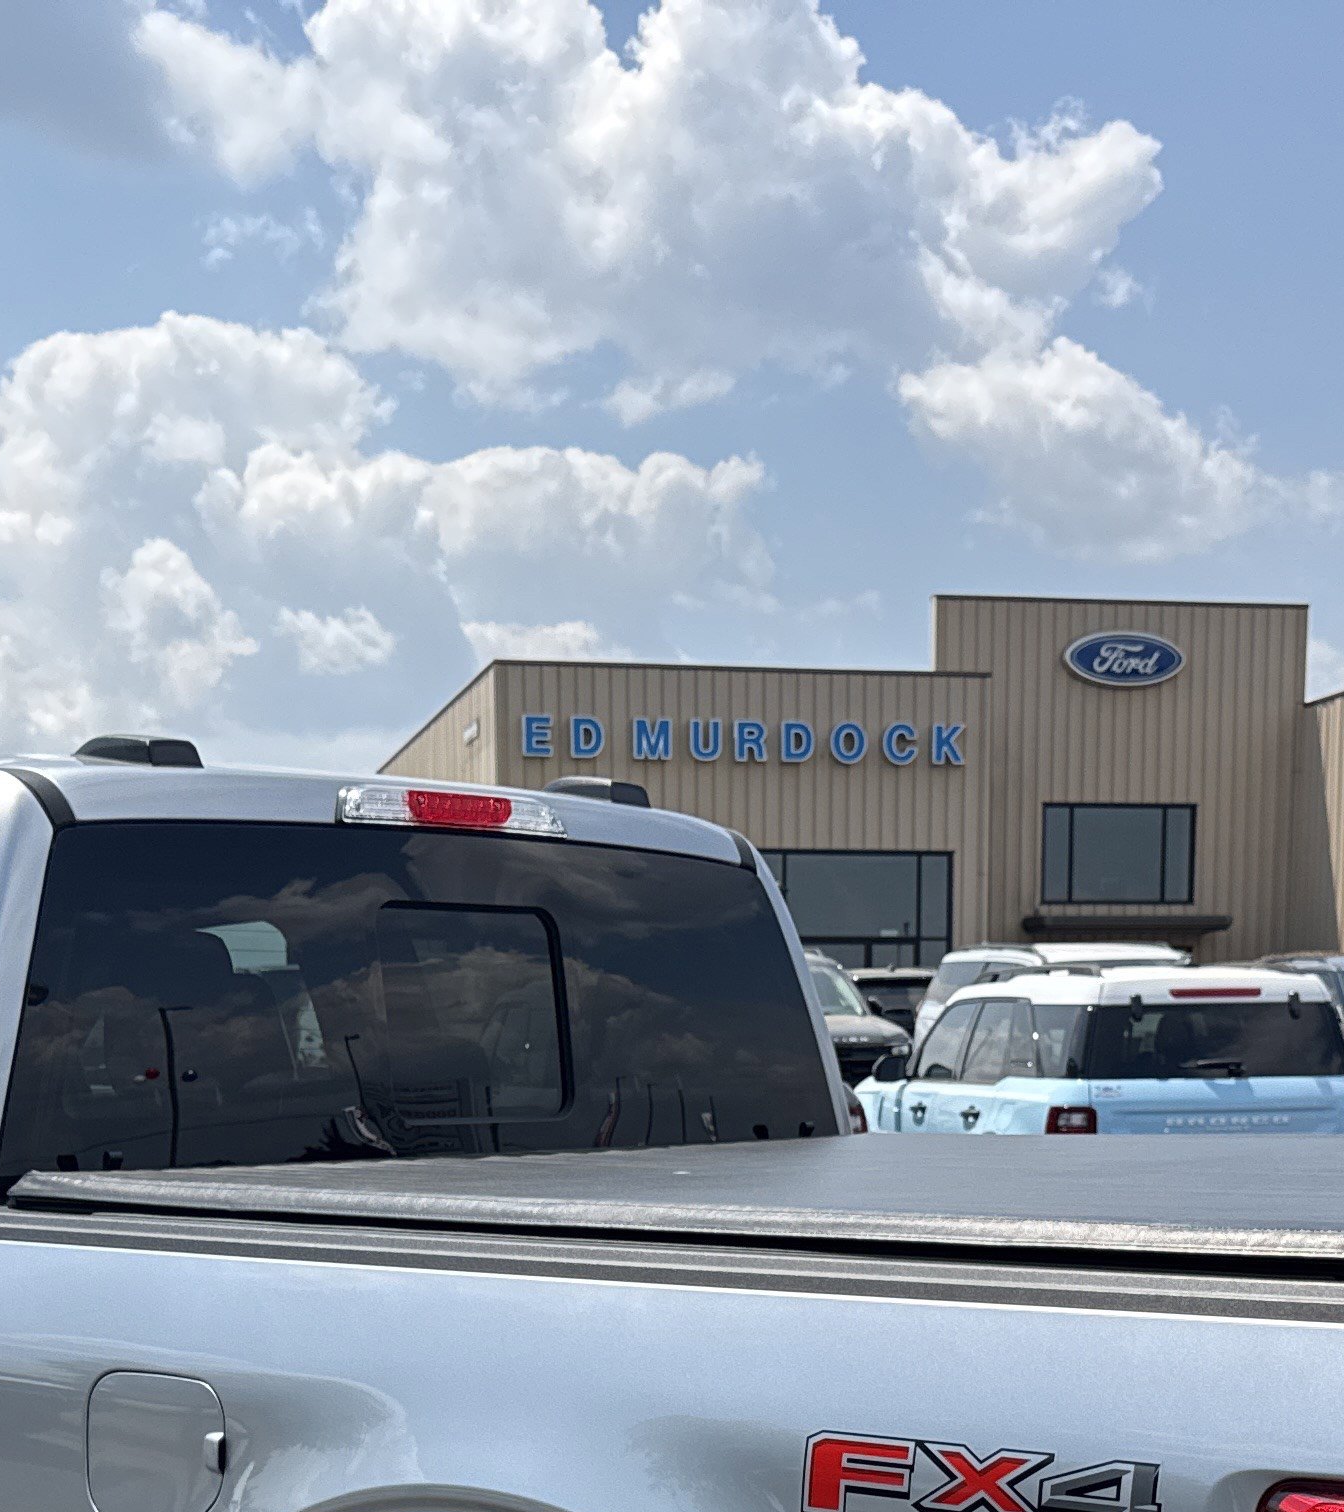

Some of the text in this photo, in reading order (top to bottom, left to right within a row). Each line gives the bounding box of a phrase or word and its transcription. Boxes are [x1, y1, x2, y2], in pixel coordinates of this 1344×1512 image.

[1092, 642, 1162, 674] Ford
[522, 713, 966, 766] ED MURDOCK
